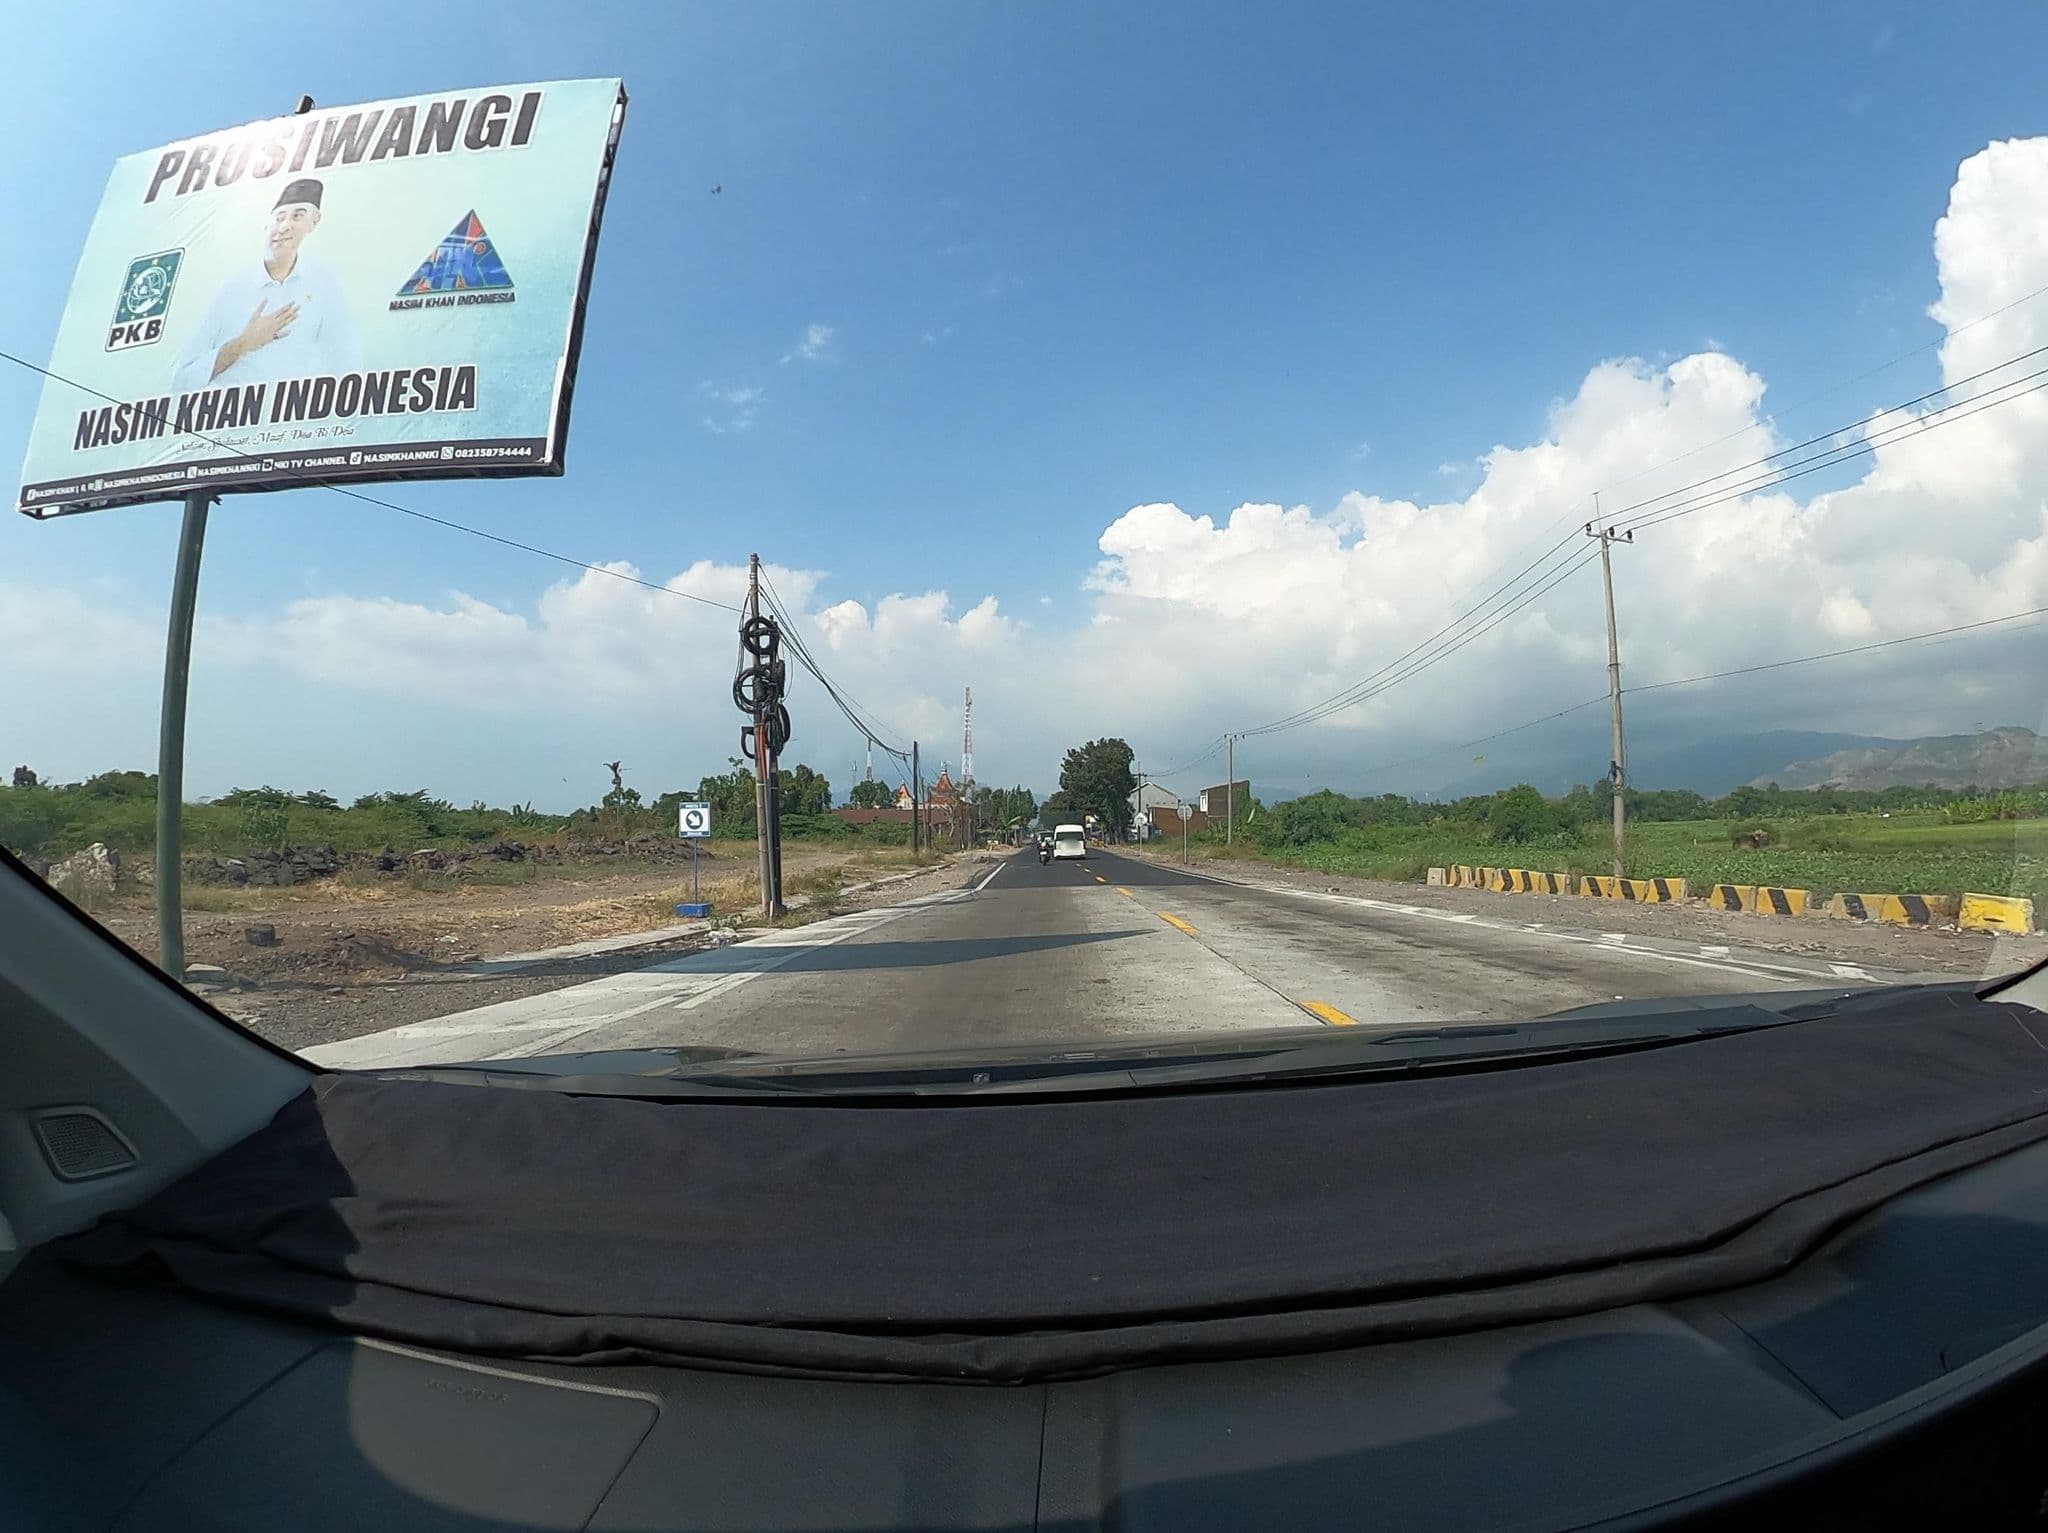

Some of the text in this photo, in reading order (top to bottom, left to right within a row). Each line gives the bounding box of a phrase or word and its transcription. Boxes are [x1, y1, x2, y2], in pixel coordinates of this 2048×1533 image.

[389, 292, 516, 311] NASIM KHAN INDONESIA
[109, 318, 162, 348] PKB
[73, 366, 476, 450] NASIM KHAN INDONESIA
[455, 447, 532, 458] 082358754444
[291, 460, 303, 469] TV
[305, 456, 347, 467] CHANNEL
